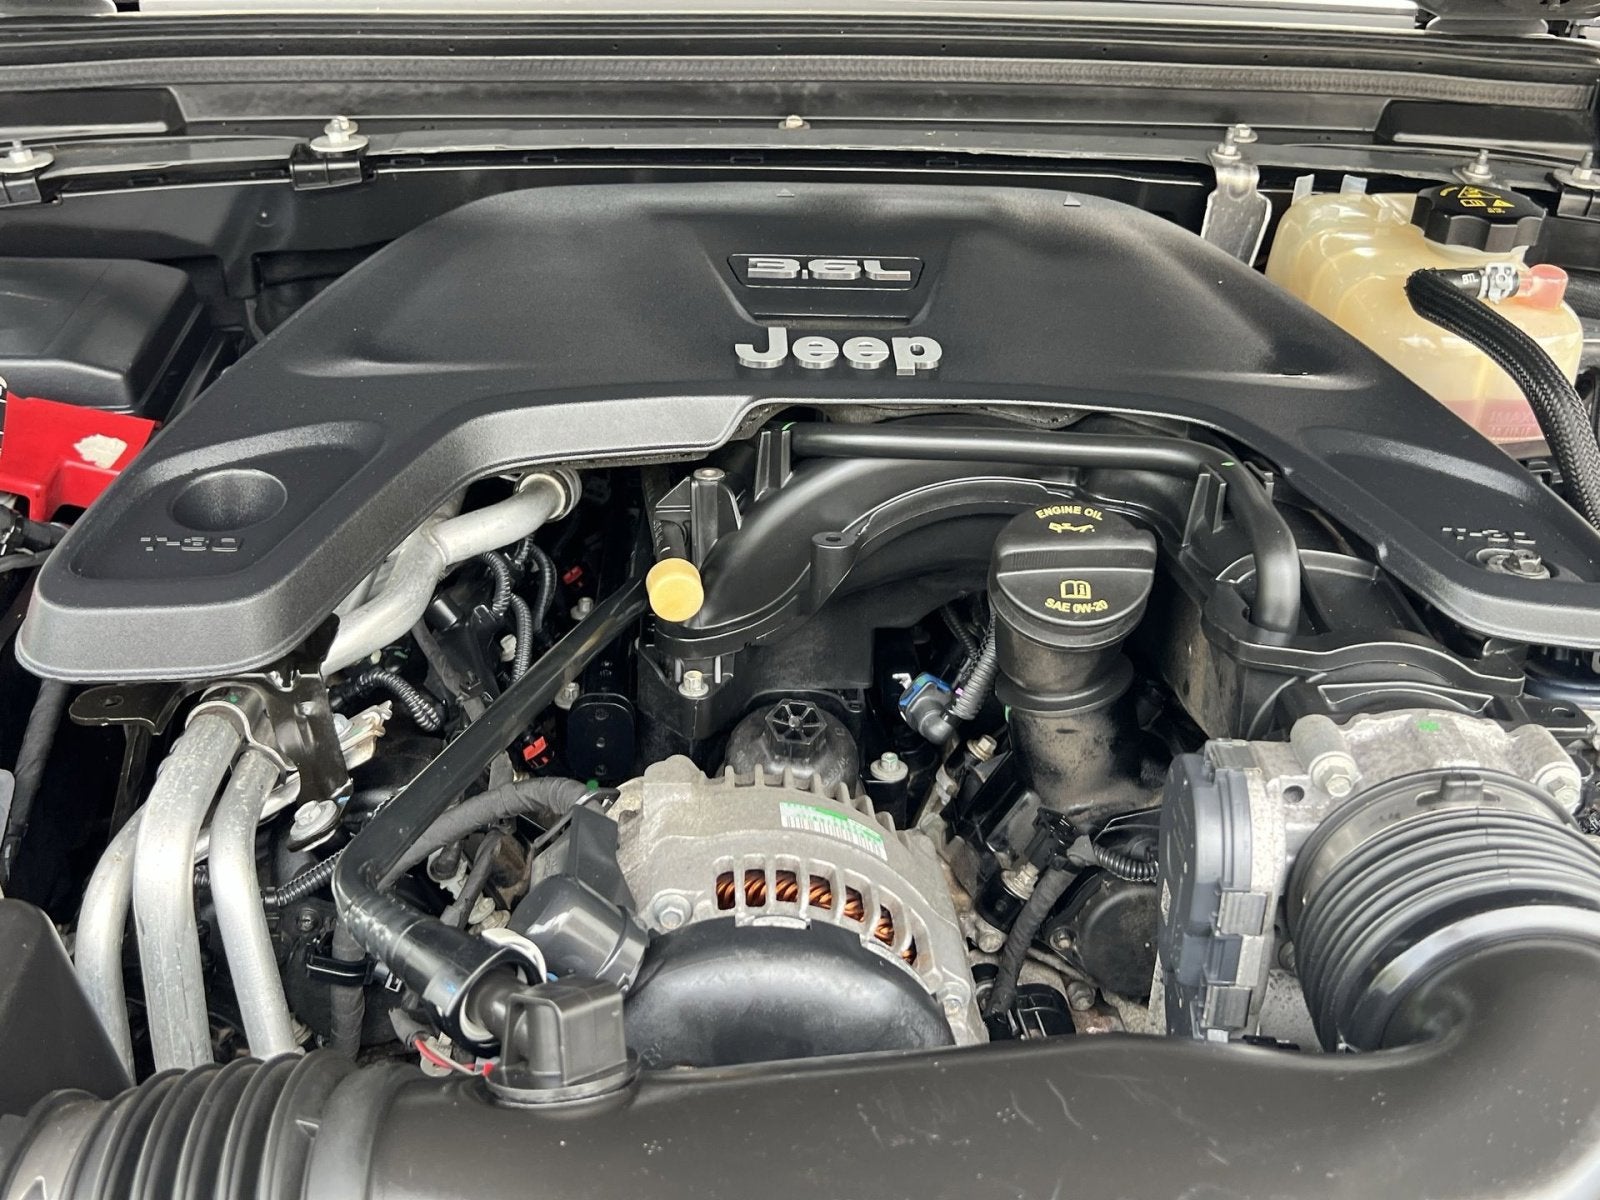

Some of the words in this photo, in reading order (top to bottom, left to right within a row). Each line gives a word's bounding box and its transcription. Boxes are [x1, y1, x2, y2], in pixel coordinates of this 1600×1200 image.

[747, 257, 911, 281] 3.6L
[734, 327, 943, 375] Jeep
[1035, 505, 1082, 519] ENGINE
[1084, 507, 1104, 521] OIL
[1044, 597, 1071, 613] SAE
[1072, 599, 1109, 614] 0W-20
